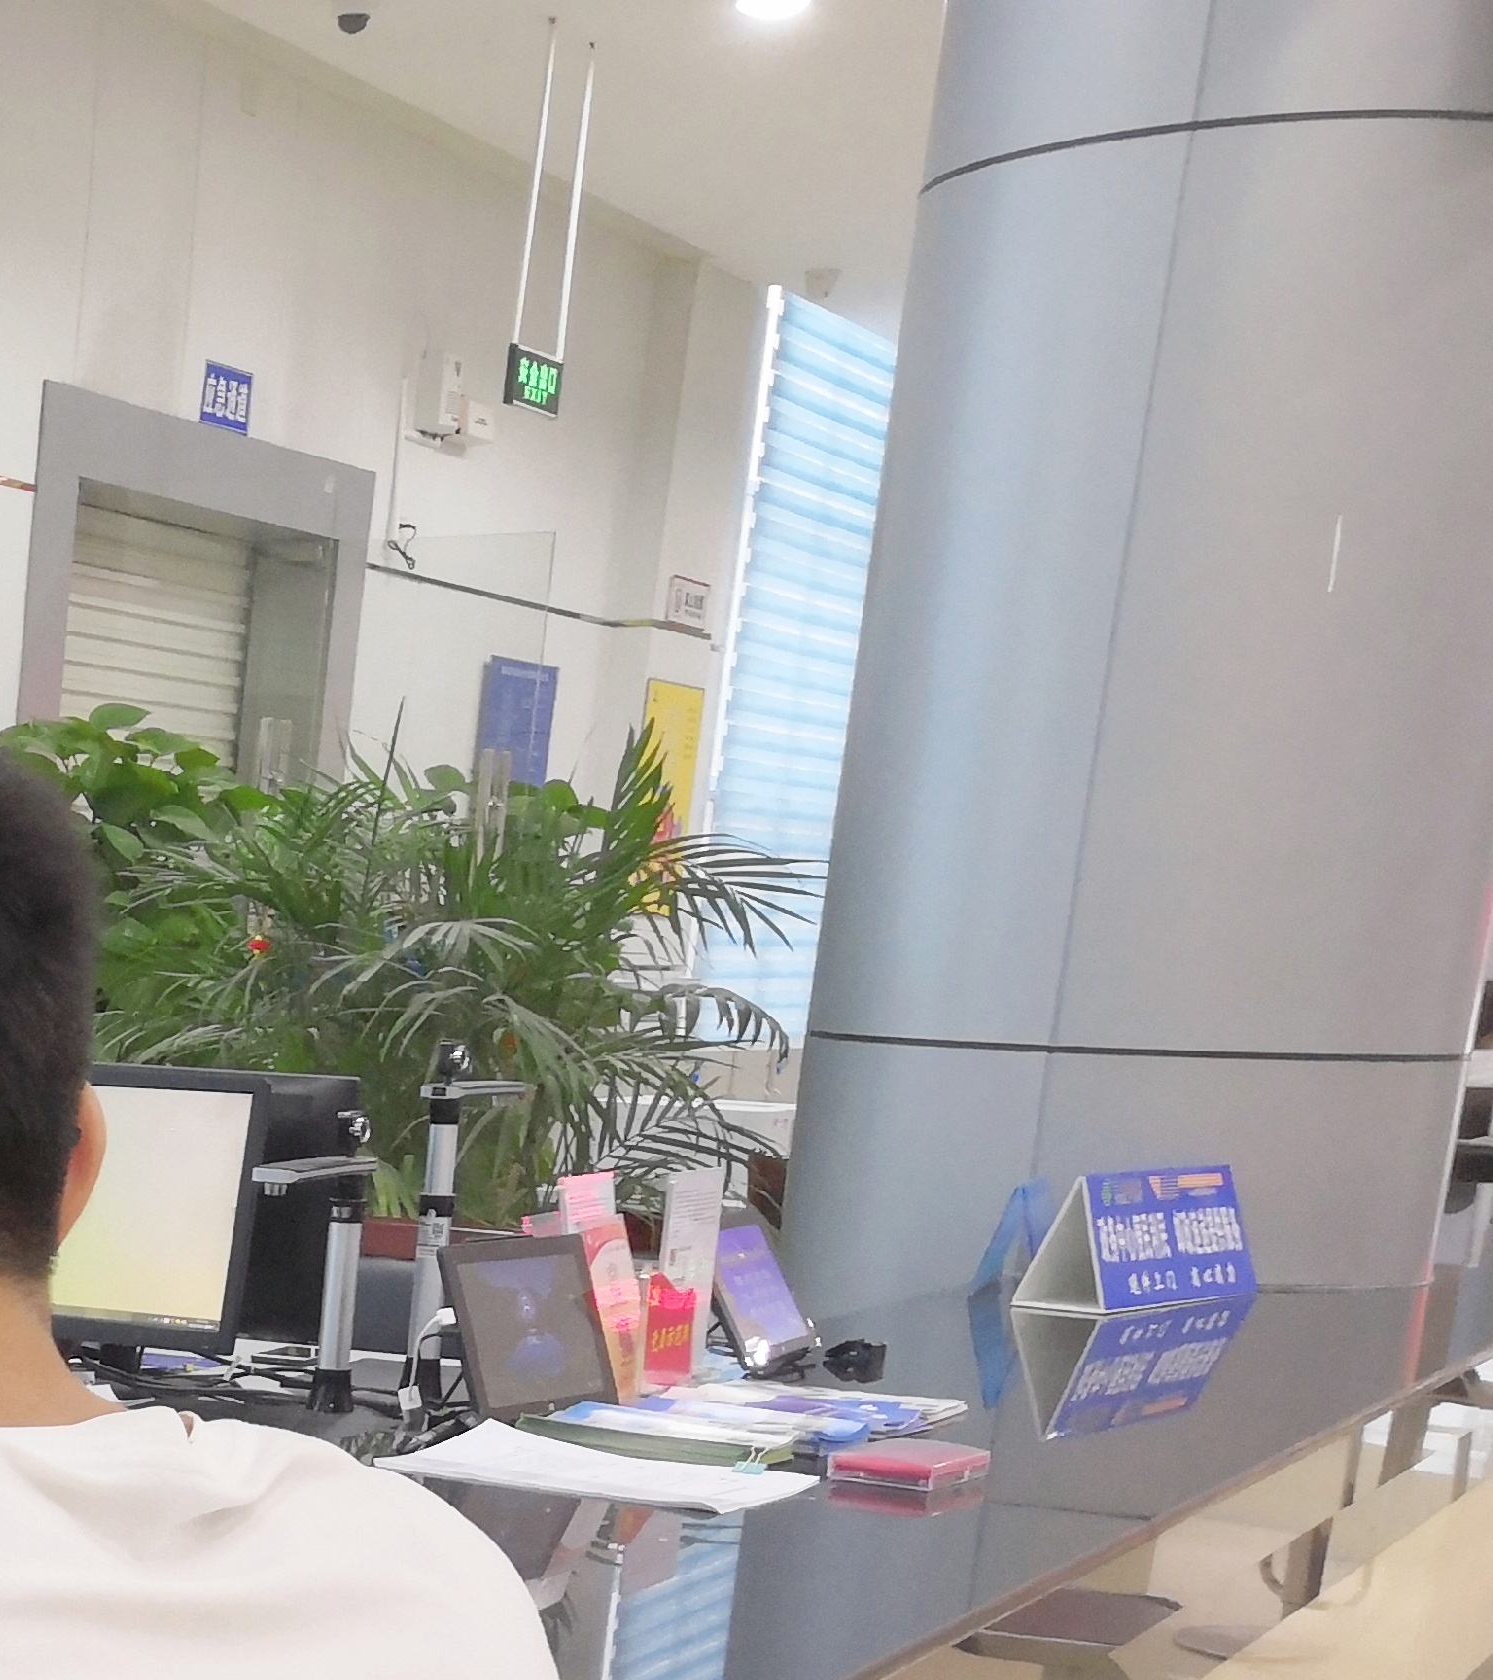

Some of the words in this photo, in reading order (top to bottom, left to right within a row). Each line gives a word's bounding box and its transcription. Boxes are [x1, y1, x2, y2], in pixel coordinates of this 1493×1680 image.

[518, 357, 558, 394] 安全出口
[203, 373, 248, 423] 应急通道
[523, 385, 548, 405] EXIT
